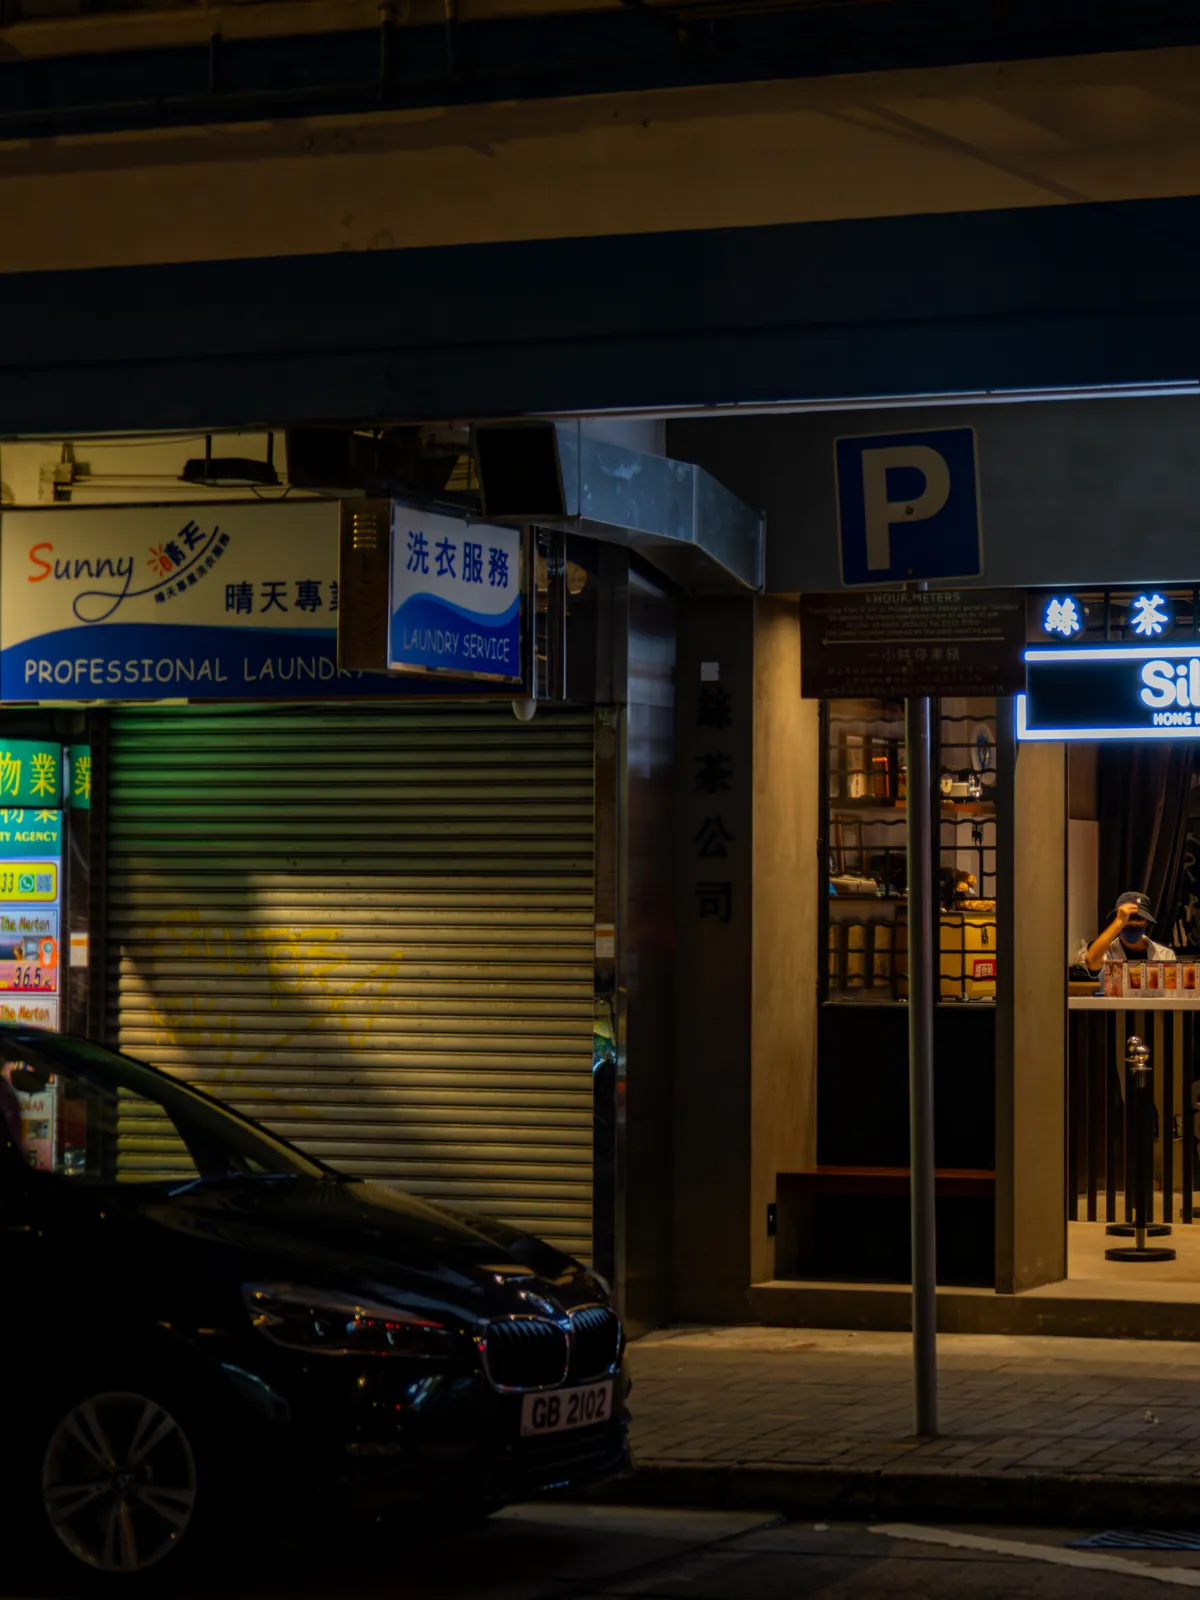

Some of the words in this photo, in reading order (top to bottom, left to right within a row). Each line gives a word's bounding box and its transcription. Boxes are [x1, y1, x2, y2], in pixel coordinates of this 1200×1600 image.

[861, 445, 951, 572] P
[28, 542, 135, 606] Sunny
[406, 530, 510, 589] 洗衣服務
[403, 625, 460, 655] LAUNDRY
[463, 633, 511, 663] SERVICE
[24, 657, 229, 686] PROFESSIONAL
[243, 655, 363, 684] LAUND
[1153, 712, 1192, 726] HONG
[14, 831, 58, 843] AGENCY
[532, 1396, 560, 1428] GB
[566, 1387, 606, 1424] 2102
